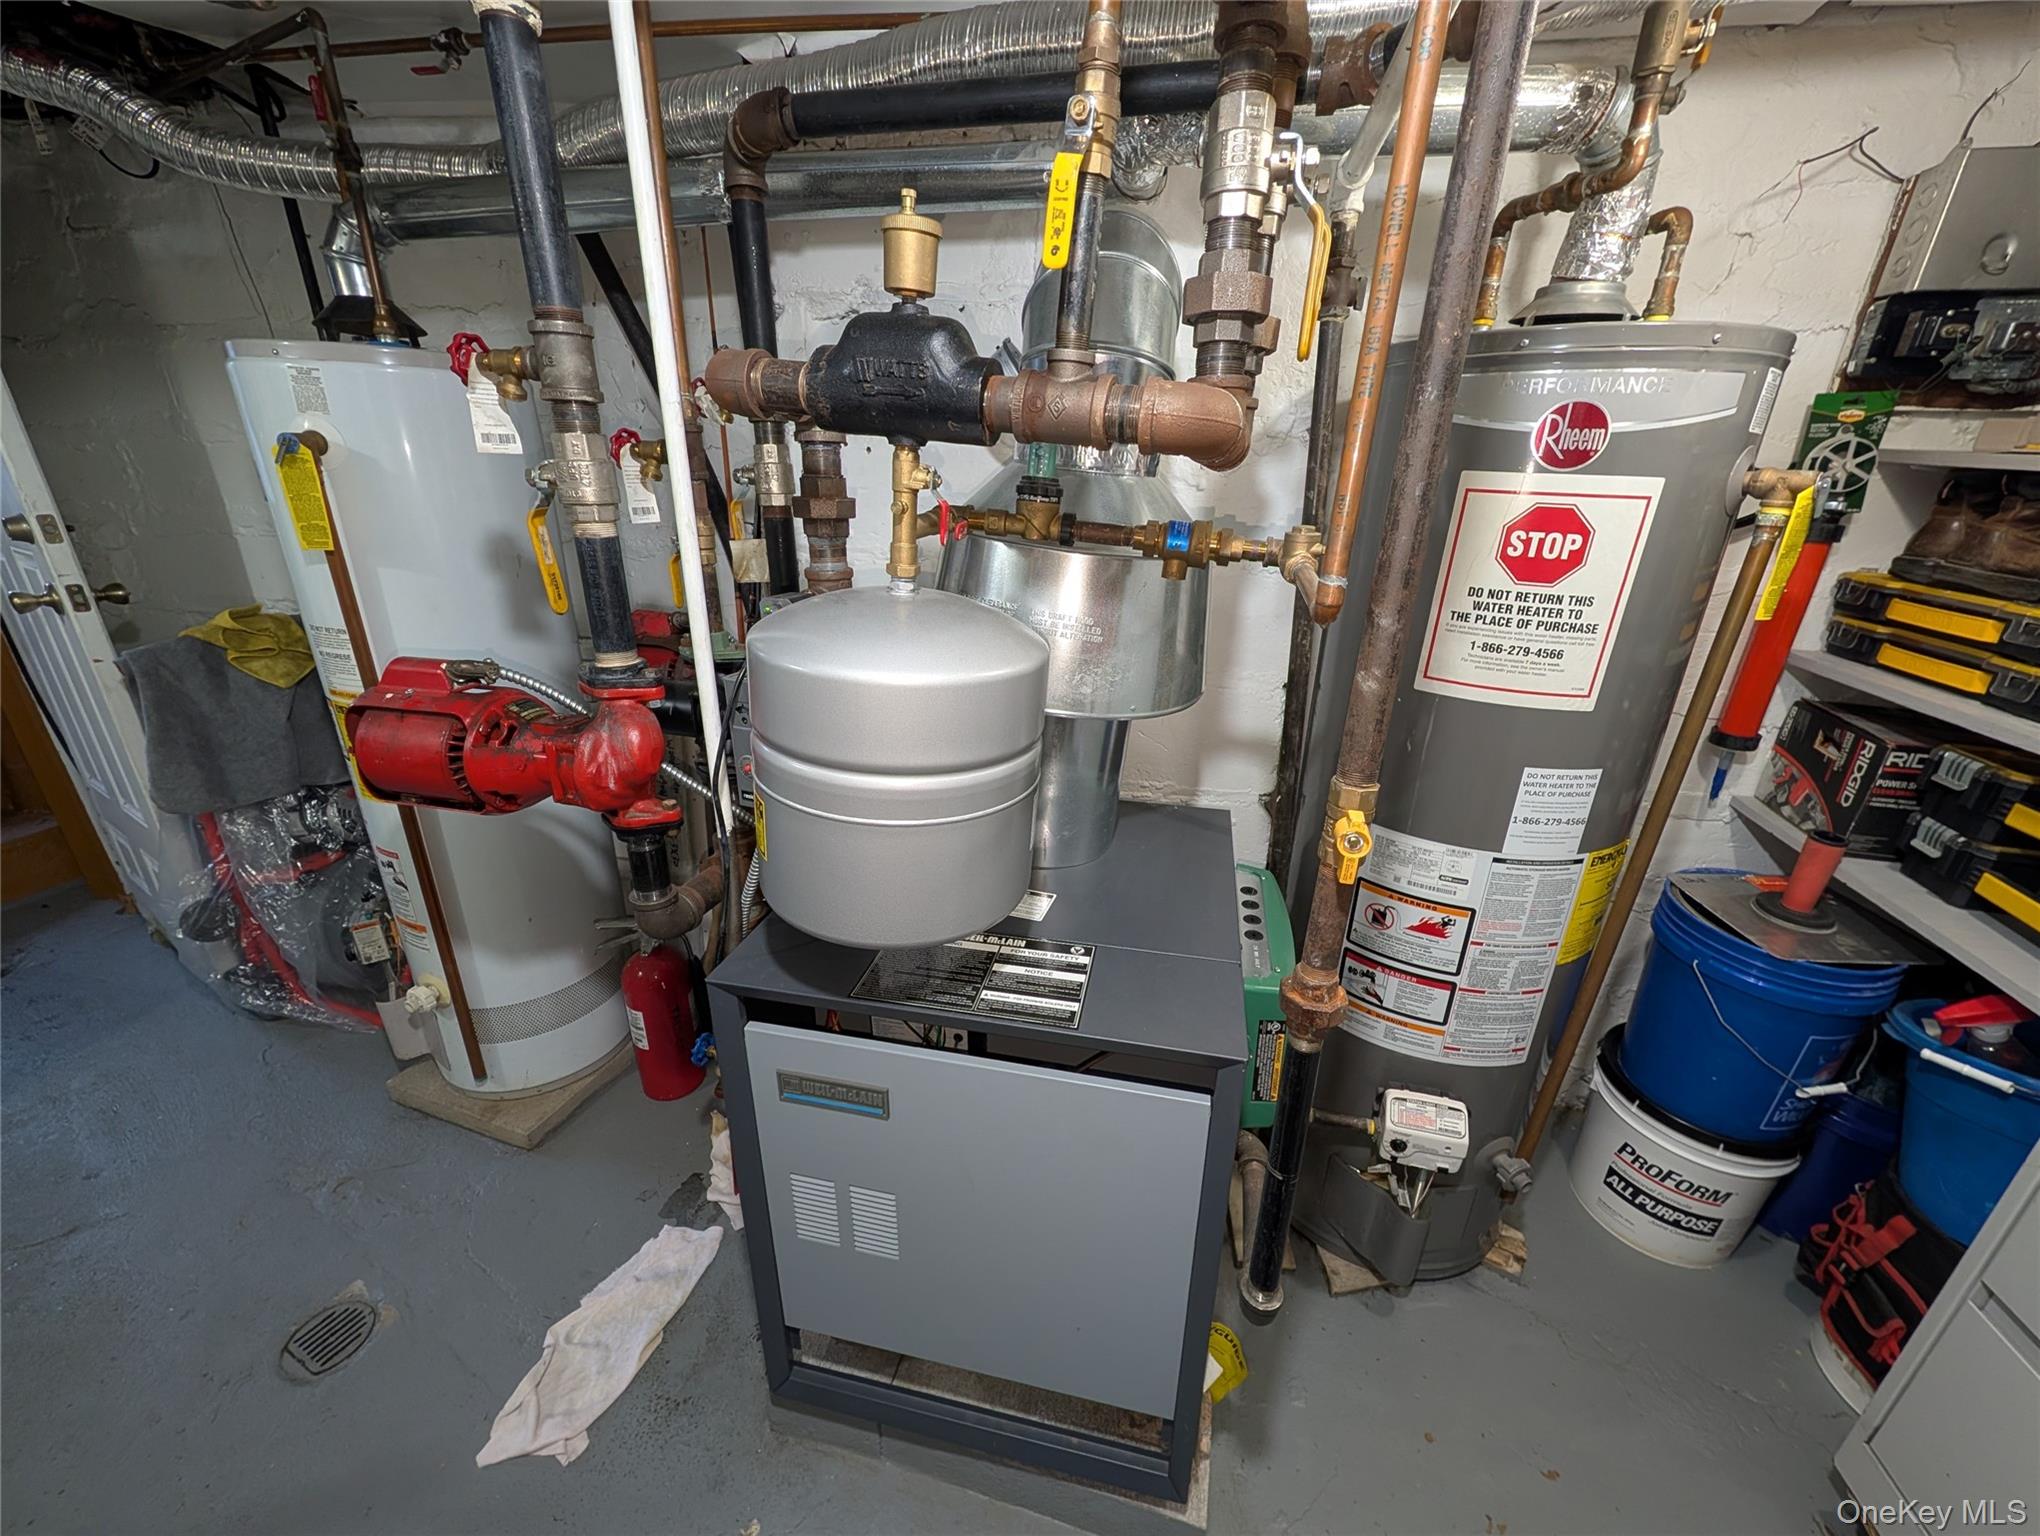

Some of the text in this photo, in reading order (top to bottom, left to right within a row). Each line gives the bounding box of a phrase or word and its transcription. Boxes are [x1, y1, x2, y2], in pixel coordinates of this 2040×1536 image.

[1364, 325, 1382, 357] USA
[1538, 403, 1606, 460] Rheem
[1506, 529, 1583, 560] STOP
[1467, 586, 1595, 608] DO NOT RETURN THIS
[1472, 600, 1584, 620] WATER HEATER TO
[1450, 610, 1600, 635] THE PLACE OF PURCHASE
[1470, 640, 1565, 660] 1-866-279-4566
[1526, 772, 1539, 780] DO
[1540, 773, 1556, 781] NOT
[1840, 739, 1877, 808] RIDGID
[1522, 781, 1548, 789] WATER
[1524, 789, 1545, 797] PLACE
[1511, 815, 1587, 827] 1-866-279-4566
[1395, 896, 1438, 912] WARNING
[1027, 950, 1049, 958] YOUR
[1049, 953, 1080, 962] SAFETY
[1023, 968, 1054, 977] NOTICE
[1383, 966, 1417, 983] DANGER
[1606, 1173, 1636, 1201] ALL
[1634, 1194, 1720, 1235] PURPOSE
